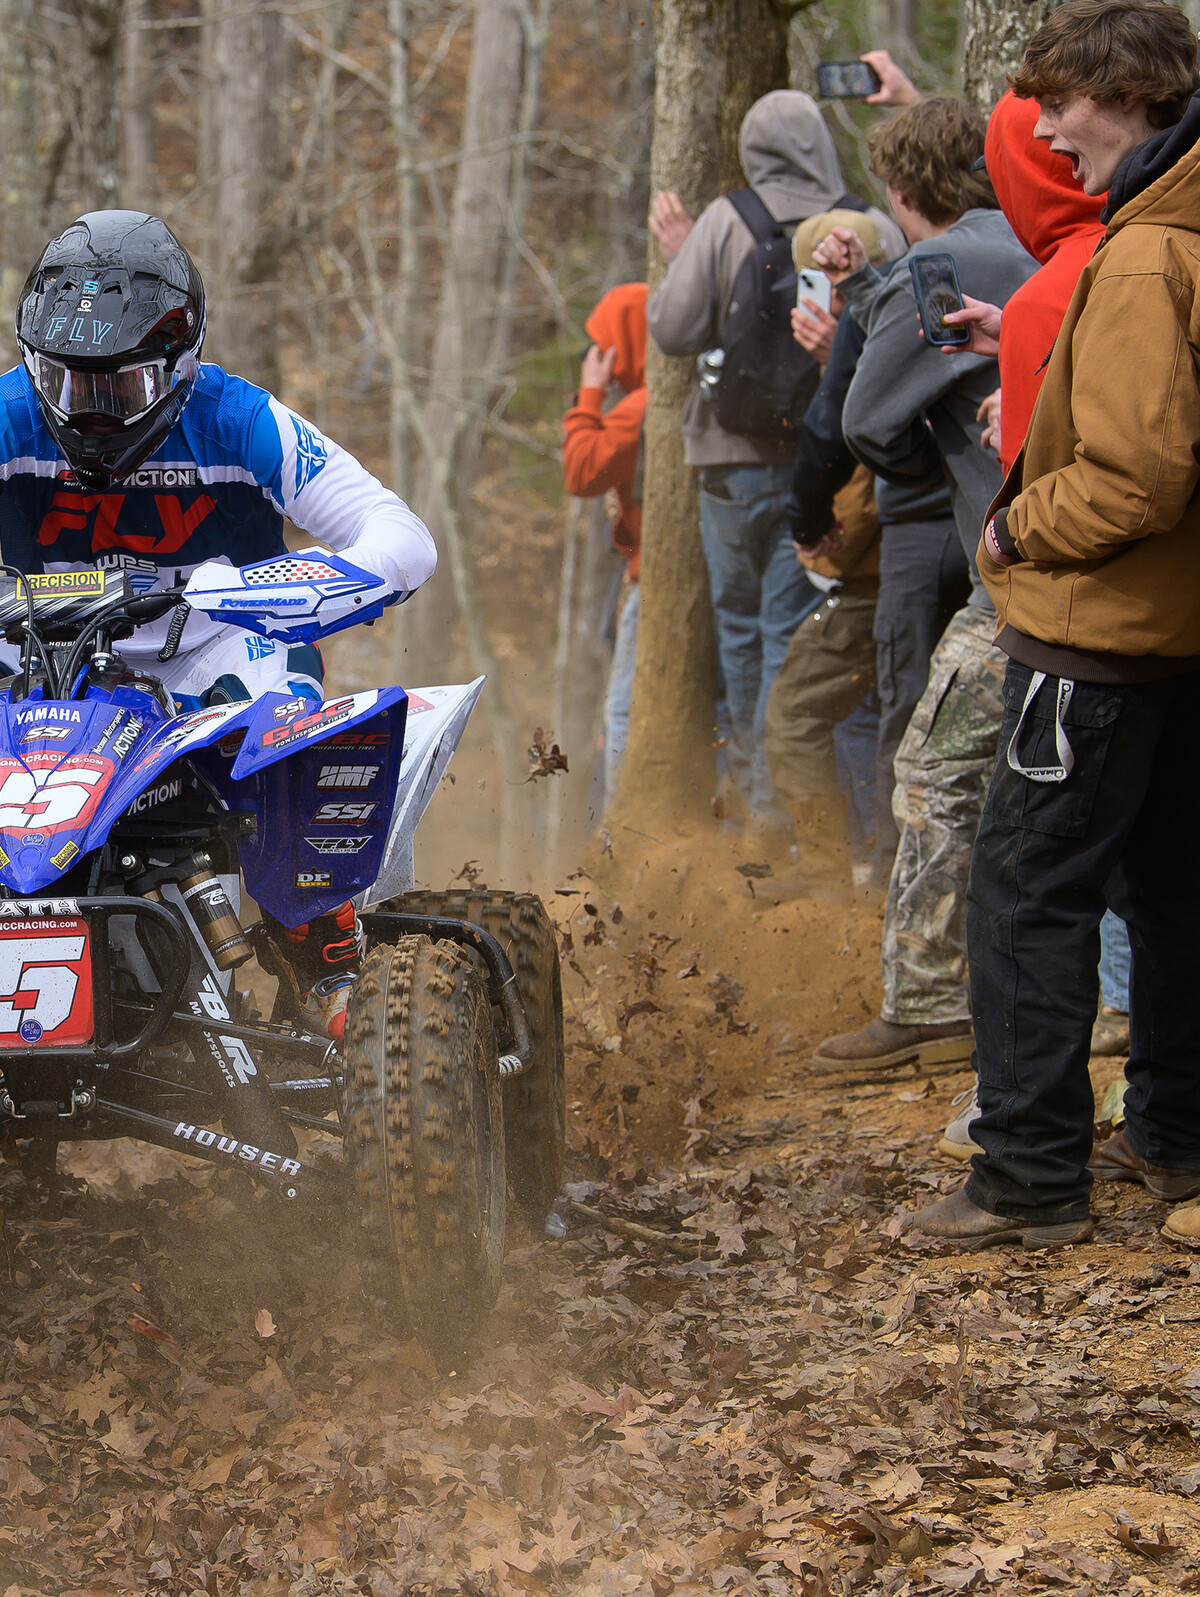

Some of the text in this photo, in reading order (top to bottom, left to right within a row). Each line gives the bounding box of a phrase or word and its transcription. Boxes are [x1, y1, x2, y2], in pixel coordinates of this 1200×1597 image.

[45, 317, 114, 345] FLY
[36, 494, 218, 554] FLY
[96, 554, 158, 574] WPS
[28, 572, 99, 590] RECISION
[48, 640, 77, 648] HOUS
[16, 706, 81, 725] YAMAHA
[273, 699, 305, 719] SSI
[262, 697, 355, 747] GBC
[275, 722, 325, 749] POWERSPORTS
[326, 711, 349, 727] TIRES
[24, 727, 71, 740] SSI
[316, 765, 380, 787] HMF
[315, 803, 376, 820] SSI
[296, 873, 331, 882] DP
[173, 1121, 301, 1176] HOUSER
